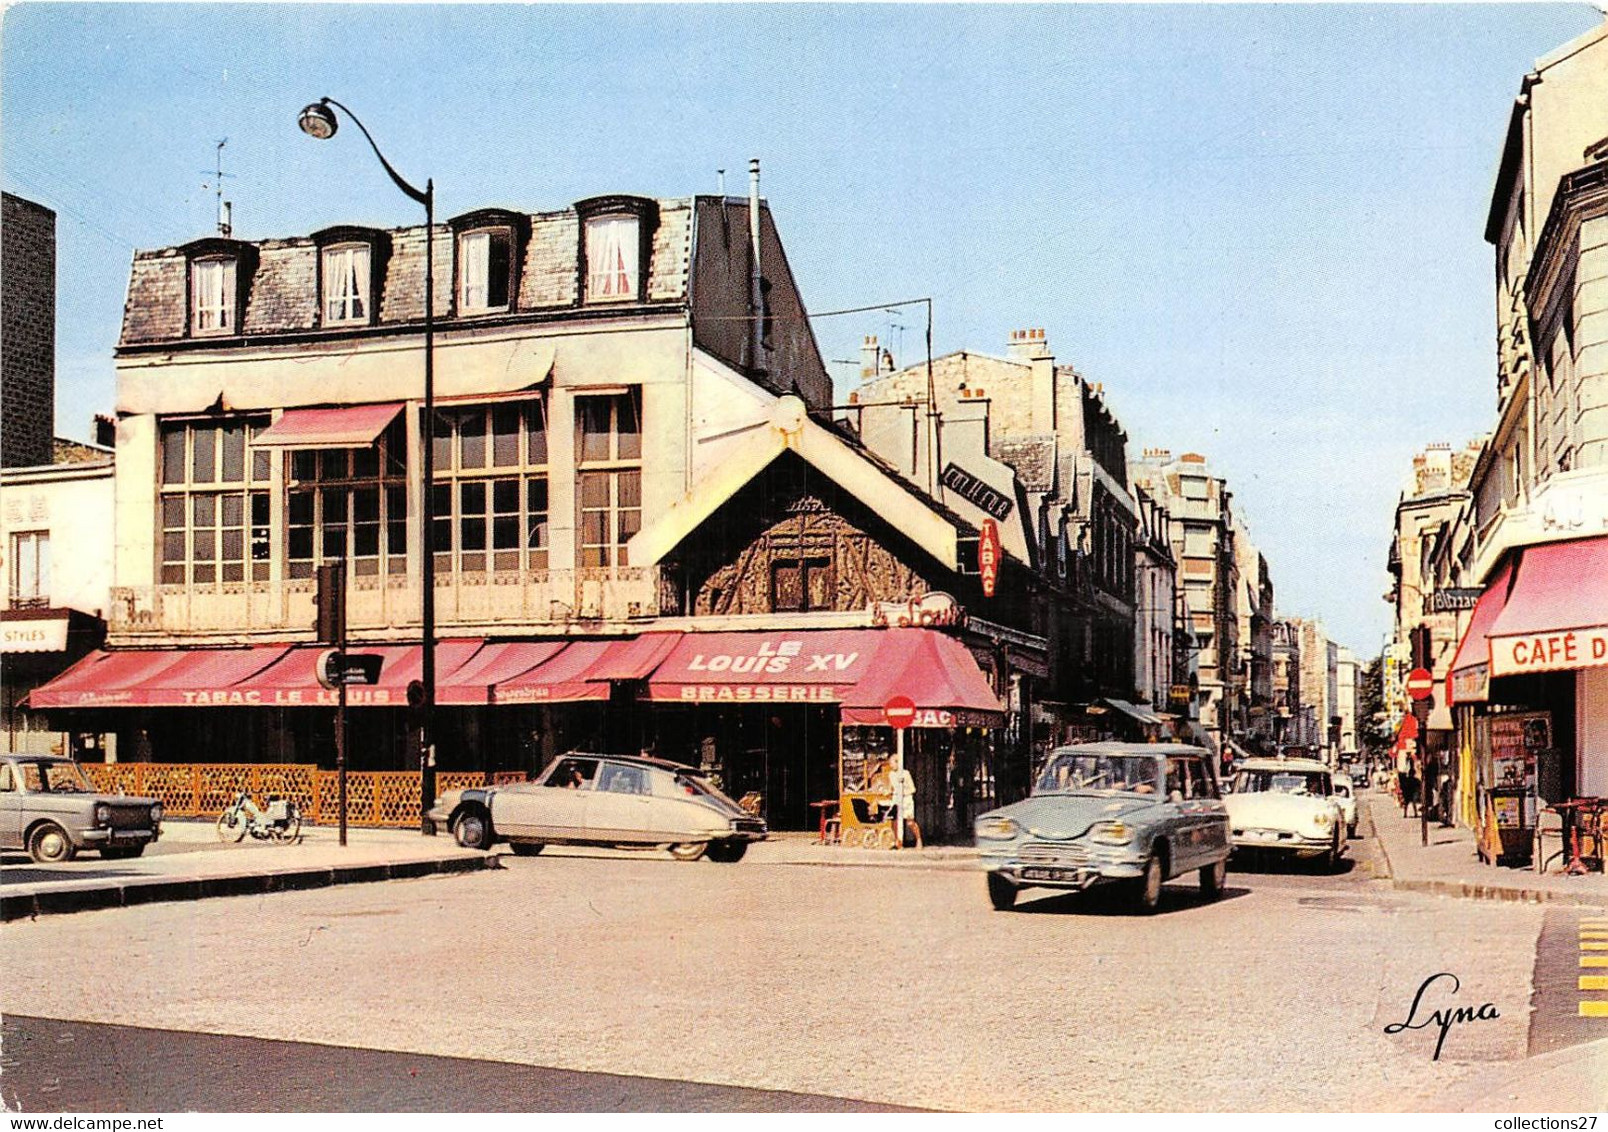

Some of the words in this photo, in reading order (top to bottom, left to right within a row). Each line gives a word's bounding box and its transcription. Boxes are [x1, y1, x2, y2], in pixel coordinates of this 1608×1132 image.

[982, 524, 995, 592] TABAC
[4, 630, 46, 643] STYLES
[757, 640, 803, 657] LE
[1512, 632, 1578, 666] CAFÉ
[687, 654, 791, 674] LOUIS
[805, 651, 859, 672] XV
[183, 690, 261, 704] TABAC
[275, 690, 302, 704] LE
[681, 686, 834, 700] BRASSERIE
